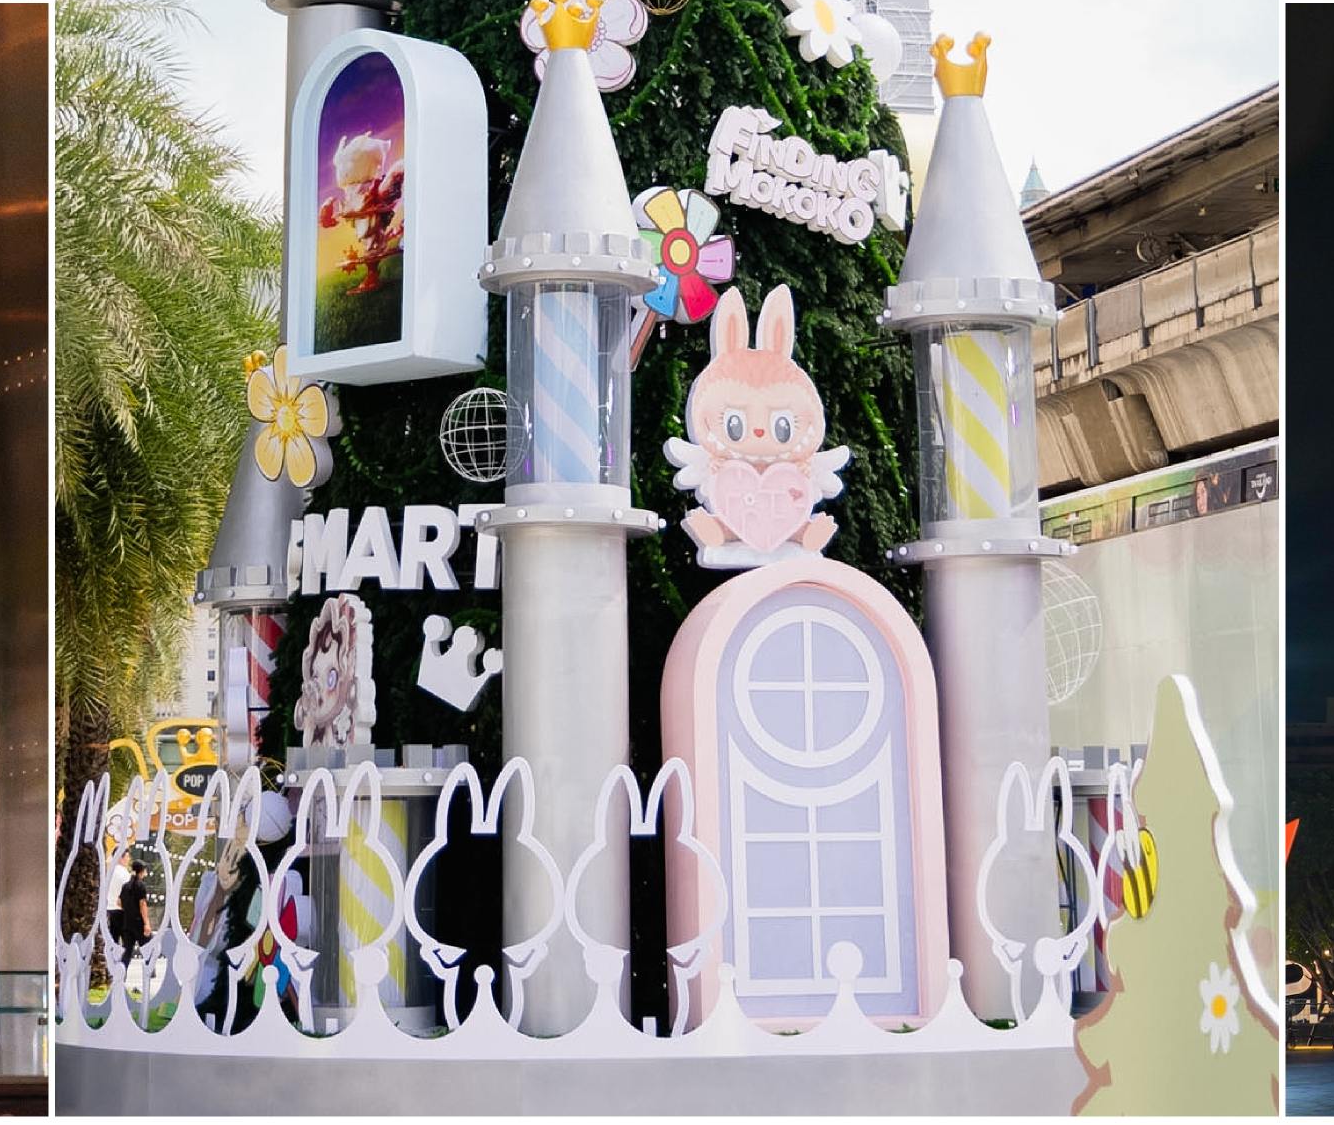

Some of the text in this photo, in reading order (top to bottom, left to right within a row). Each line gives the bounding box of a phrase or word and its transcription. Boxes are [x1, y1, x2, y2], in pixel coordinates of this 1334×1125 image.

[704, 153, 876, 245] MOKOKO
[707, 105, 881, 203] FINDING
[301, 503, 507, 596] MART
[183, 774, 204, 787] POP
